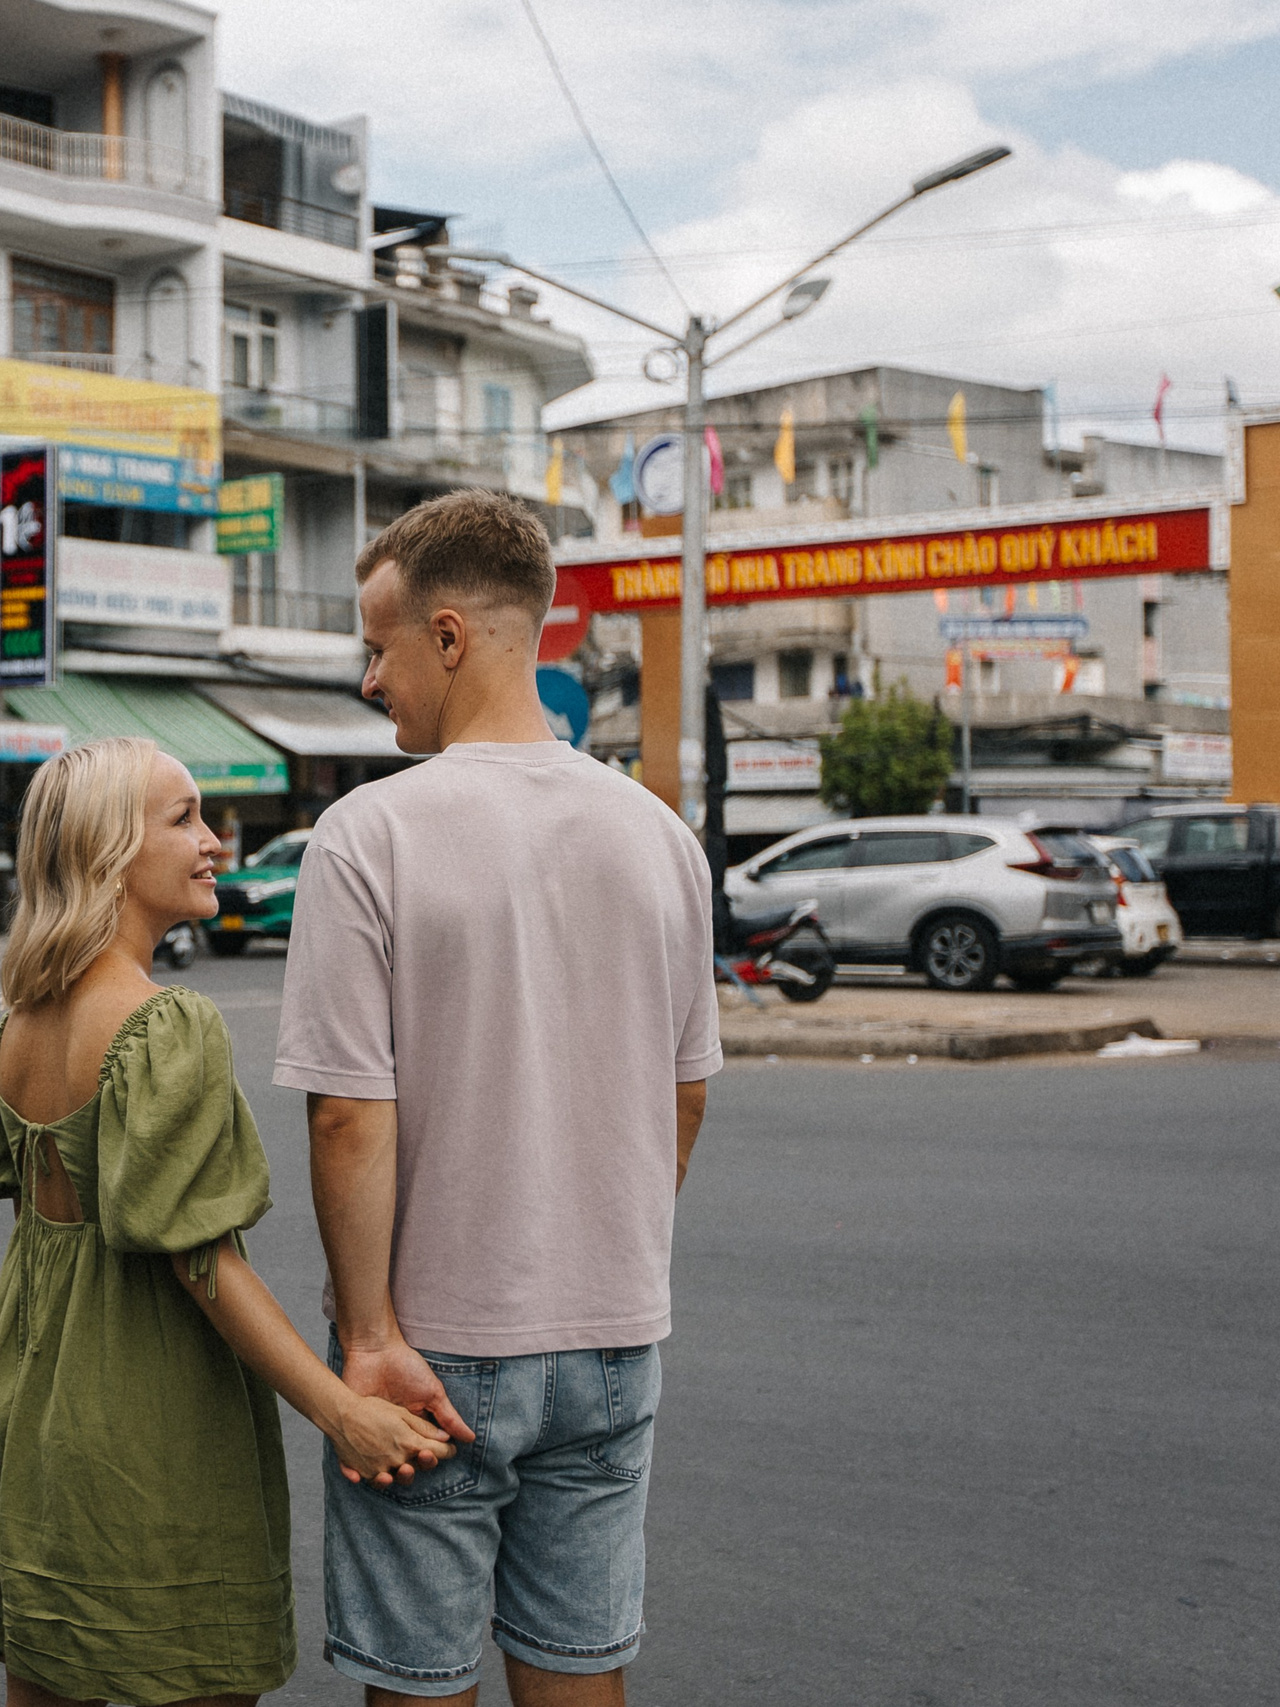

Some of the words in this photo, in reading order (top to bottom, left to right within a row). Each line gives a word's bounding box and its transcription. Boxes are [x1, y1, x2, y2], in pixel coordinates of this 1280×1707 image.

[730, 554, 780, 594] NHA
[781, 546, 862, 589] TRANG
[864, 538, 925, 584] KÍNH
[926, 530, 998, 579] CHÀO
[1000, 524, 1057, 574] QUÝ
[1059, 517, 1159, 568] KHÁCH
